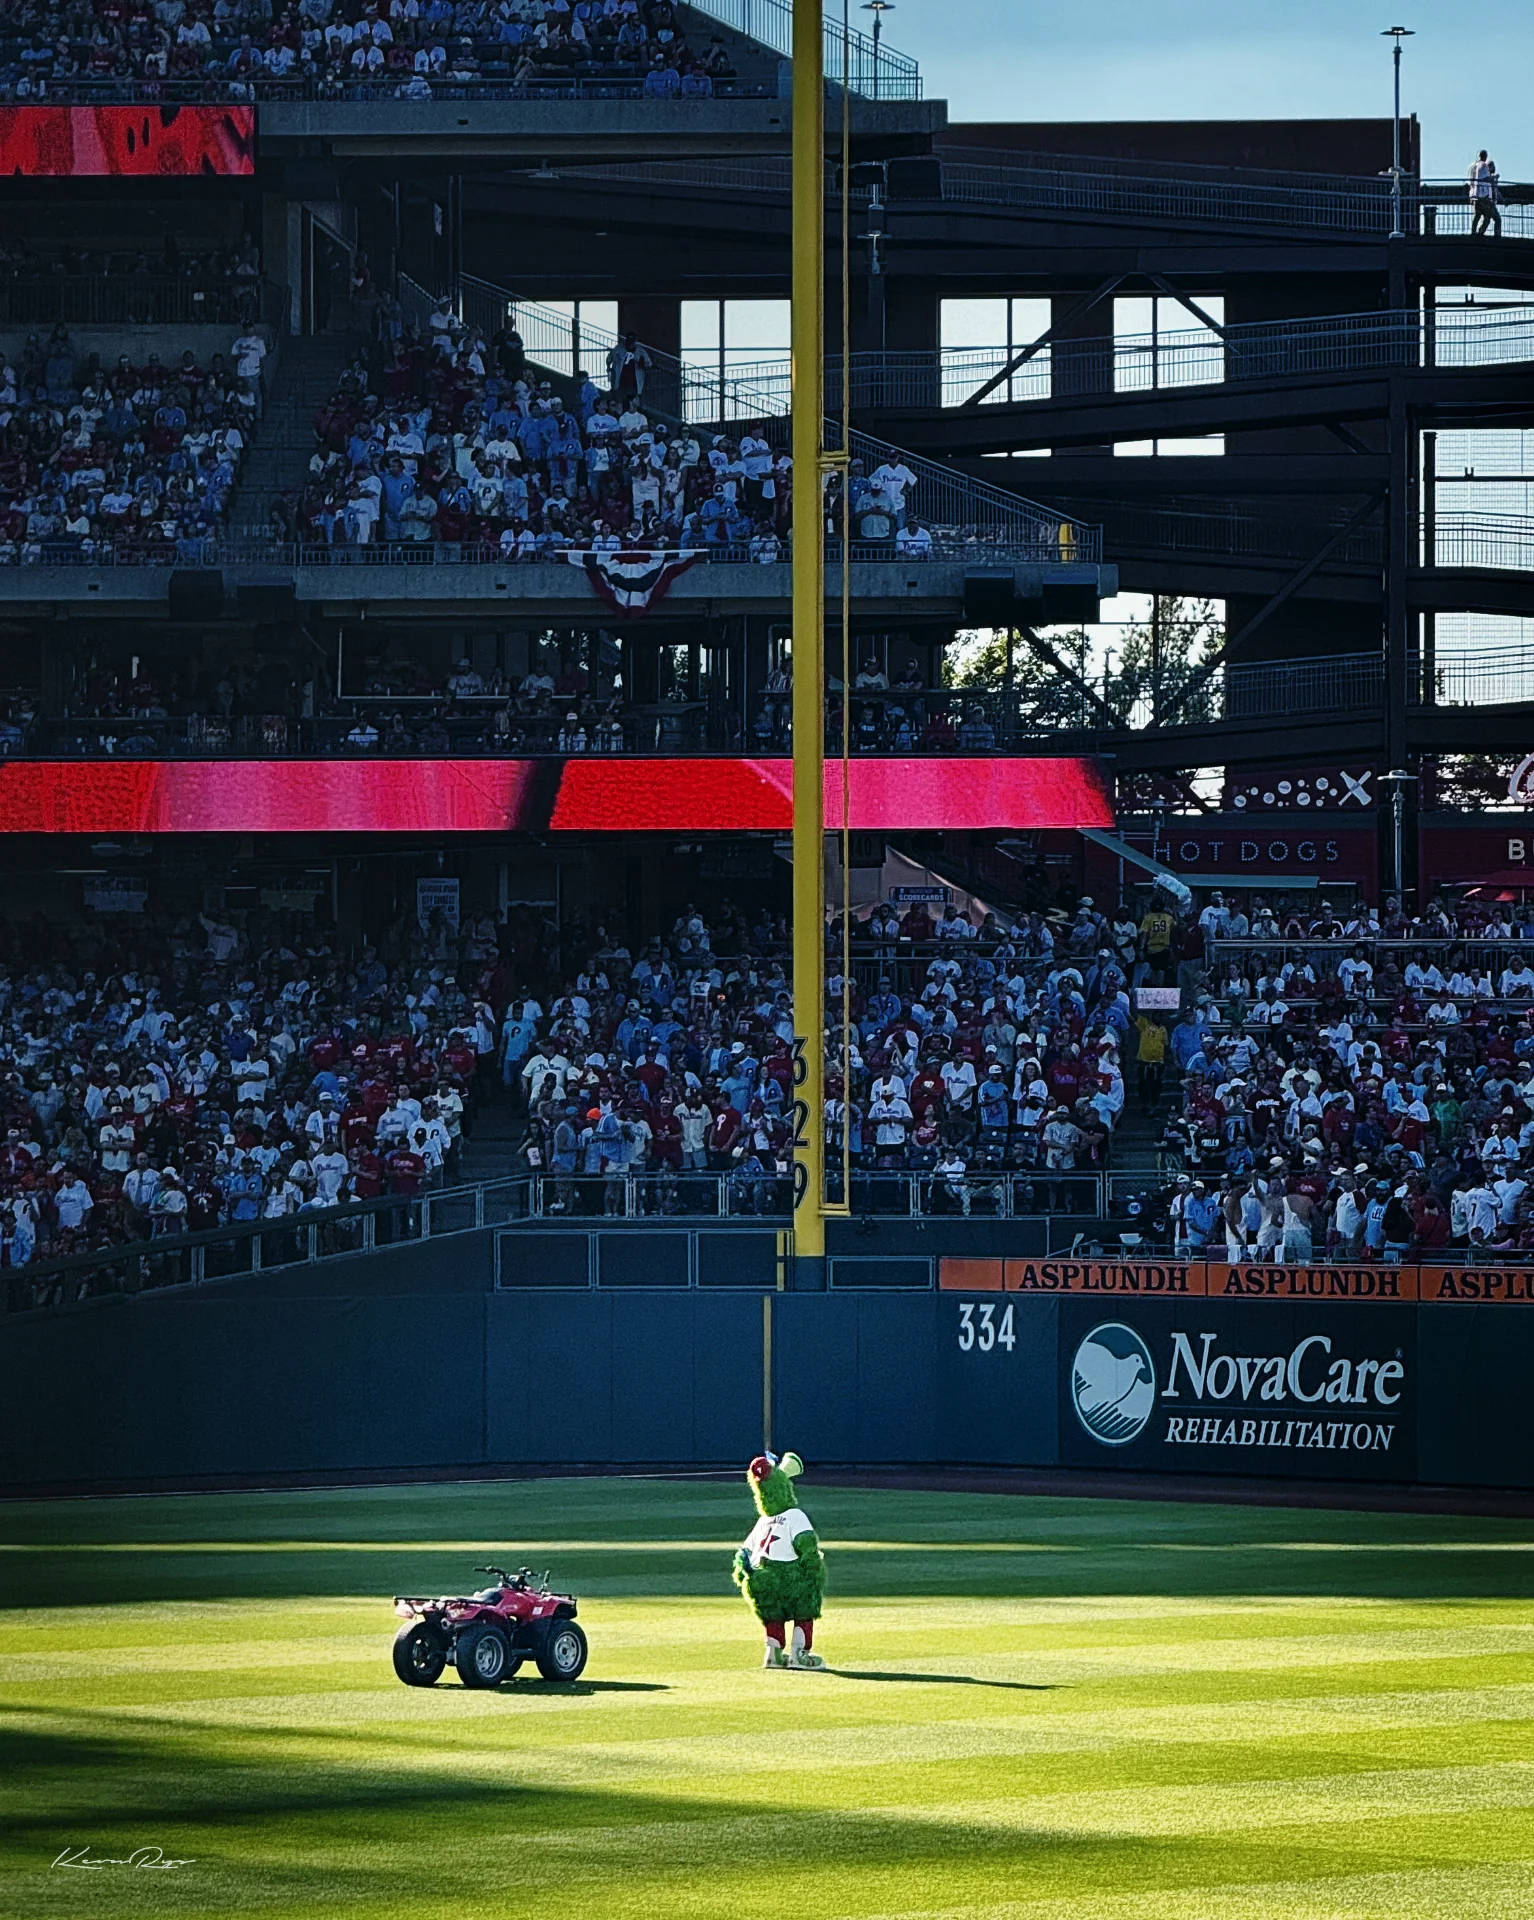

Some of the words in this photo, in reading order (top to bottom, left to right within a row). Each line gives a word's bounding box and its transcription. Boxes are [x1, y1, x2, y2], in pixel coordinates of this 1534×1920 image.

[1153, 840, 1224, 863] HOT
[1240, 840, 1340, 863] DOGS
[1152, 920, 1167, 933] 59
[716, 1113, 727, 1131] P
[1019, 1263, 1190, 1293] ASPLUNDH
[1222, 1267, 1401, 1297] ASPLUNDH
[958, 1302, 1017, 1352] 334
[1161, 1331, 1405, 1406] NovaCare
[1163, 1416, 1396, 1451] REHABILITATION
